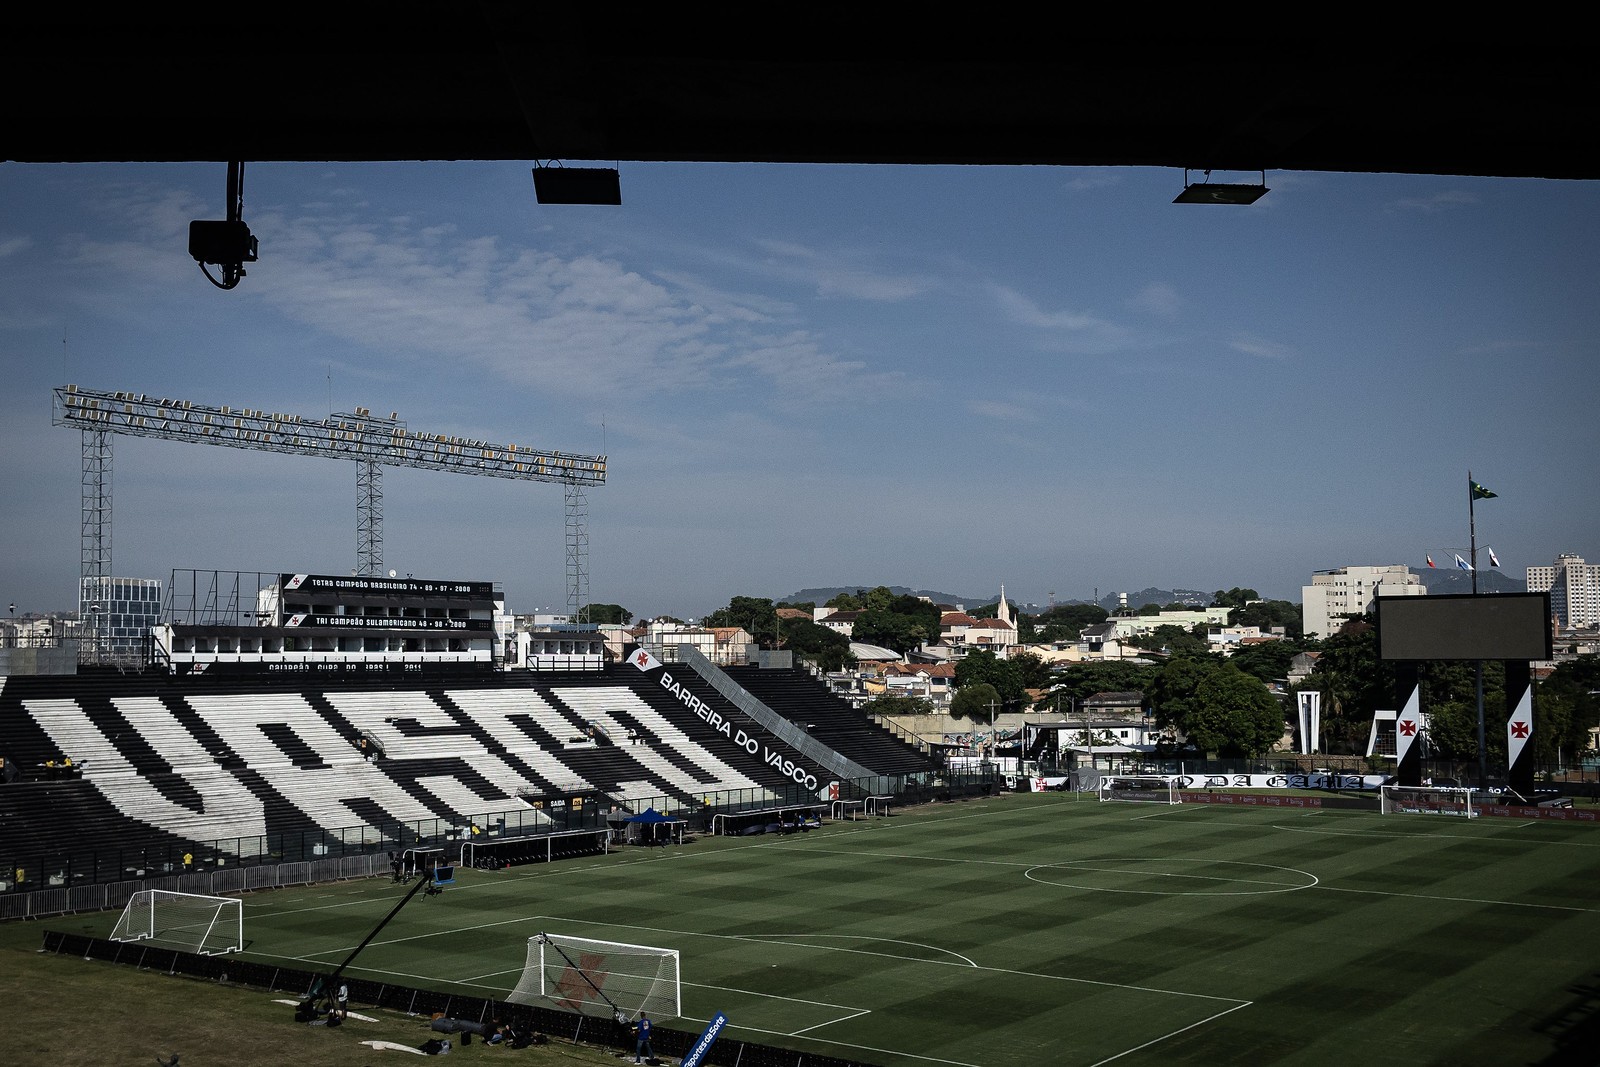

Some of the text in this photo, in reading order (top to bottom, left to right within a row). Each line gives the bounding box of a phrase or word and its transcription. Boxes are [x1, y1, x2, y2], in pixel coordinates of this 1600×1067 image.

[454, 585, 471, 593] 2000
[659, 671, 818, 791] BARREIRA DO VASCO
[1266, 775, 1365, 788] GAMA
[704, 1032, 713, 1044] da
[709, 1015, 725, 1036] Sorte
